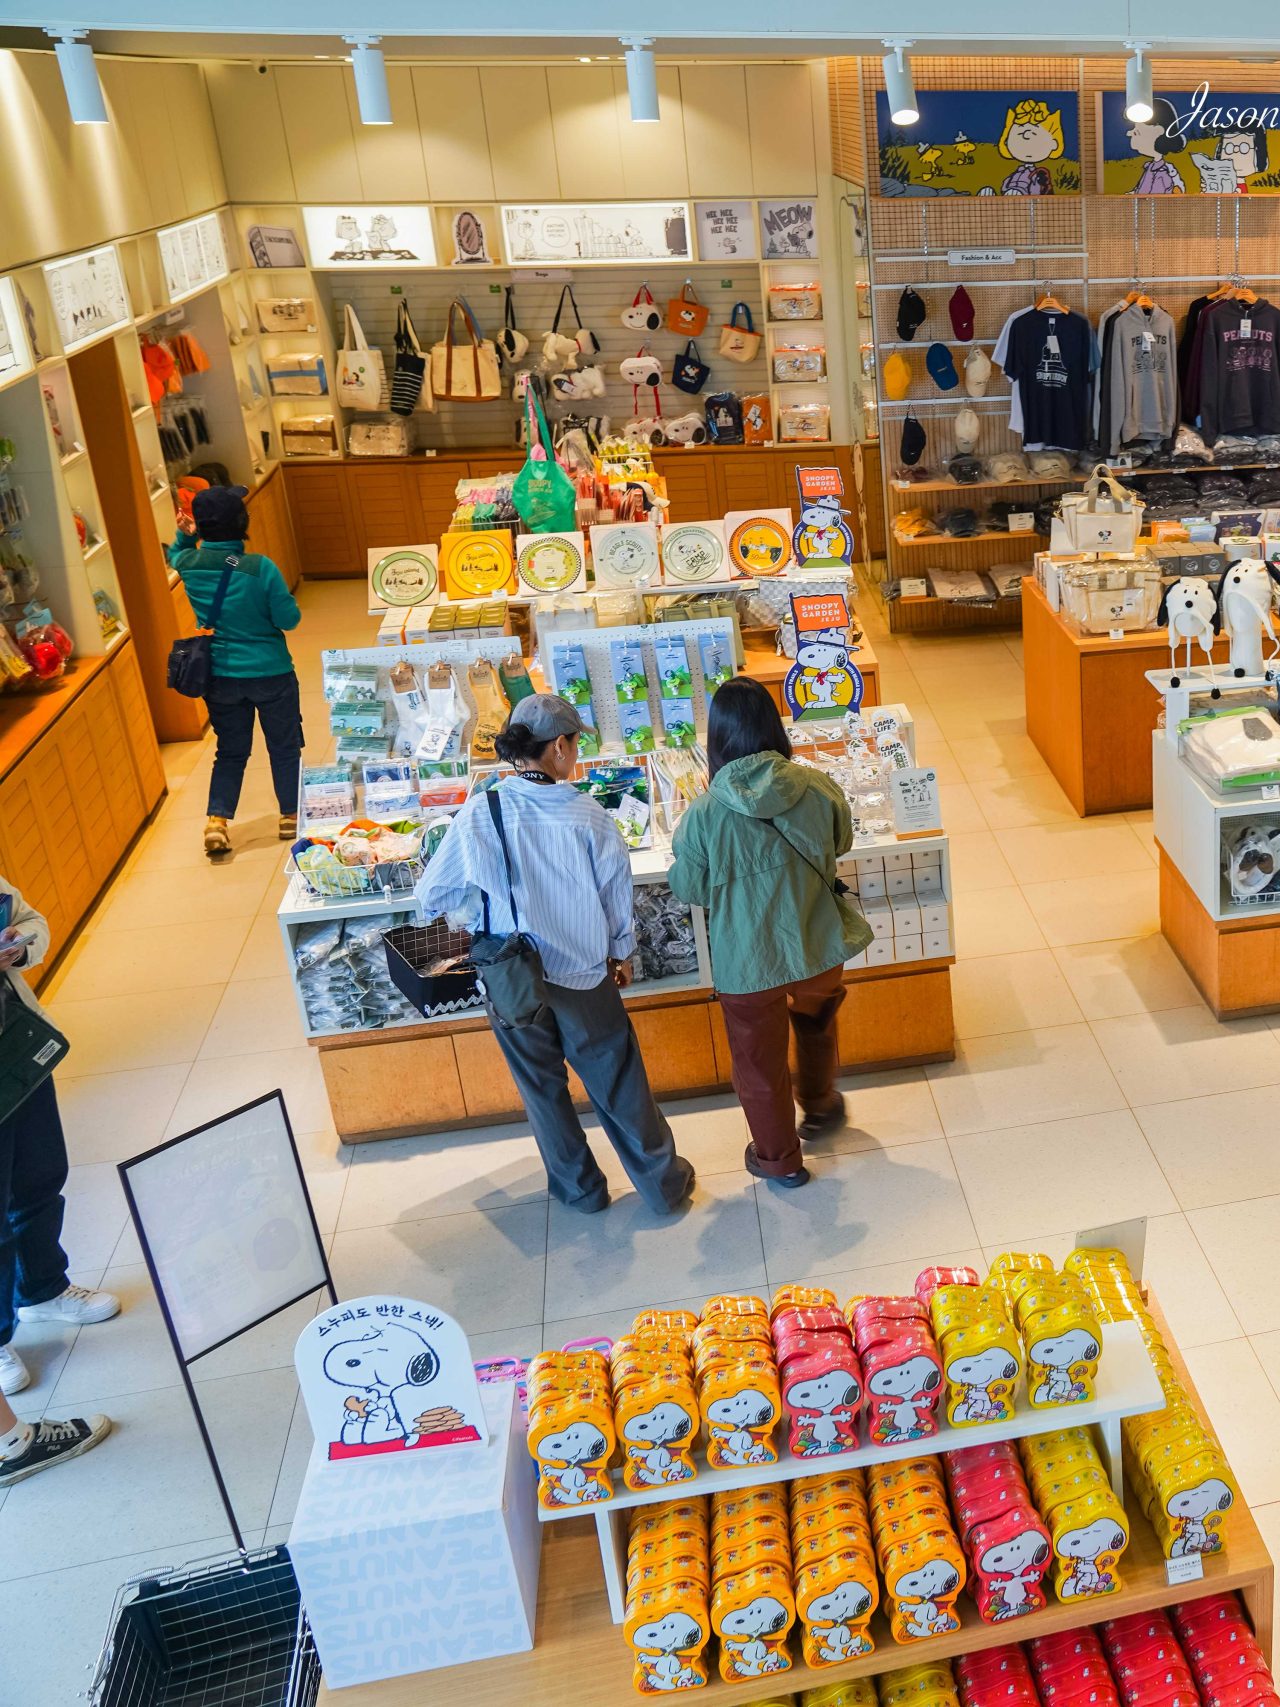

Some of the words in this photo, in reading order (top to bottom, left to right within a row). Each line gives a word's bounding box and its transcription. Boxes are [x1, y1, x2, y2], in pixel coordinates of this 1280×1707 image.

[763, 204, 813, 236] MEOW
[1131, 335, 1167, 347] PETS
[1223, 330, 1273, 342] PEAUTS
[801, 602, 840, 611] SNOOPY
[801, 609, 840, 617] GARDEN
[873, 718, 894, 728] CAMP
[876, 724, 893, 733] LIFE
[881, 743, 901, 752] CAMP
[318, 1307, 371, 1337] 스누피도
[376, 1304, 405, 1317] 반한
[408, 1311, 444, 1331] 스낵!
[46, 1444, 61, 1452] FILA
[299, 1509, 497, 1558] PEANUTS
[304, 1534, 504, 1589] PEANUTS
[313, 1564, 510, 1621] PEANUTS
[321, 1595, 517, 1649] PEANUTS
[330, 1623, 523, 1681] PEANUTS
